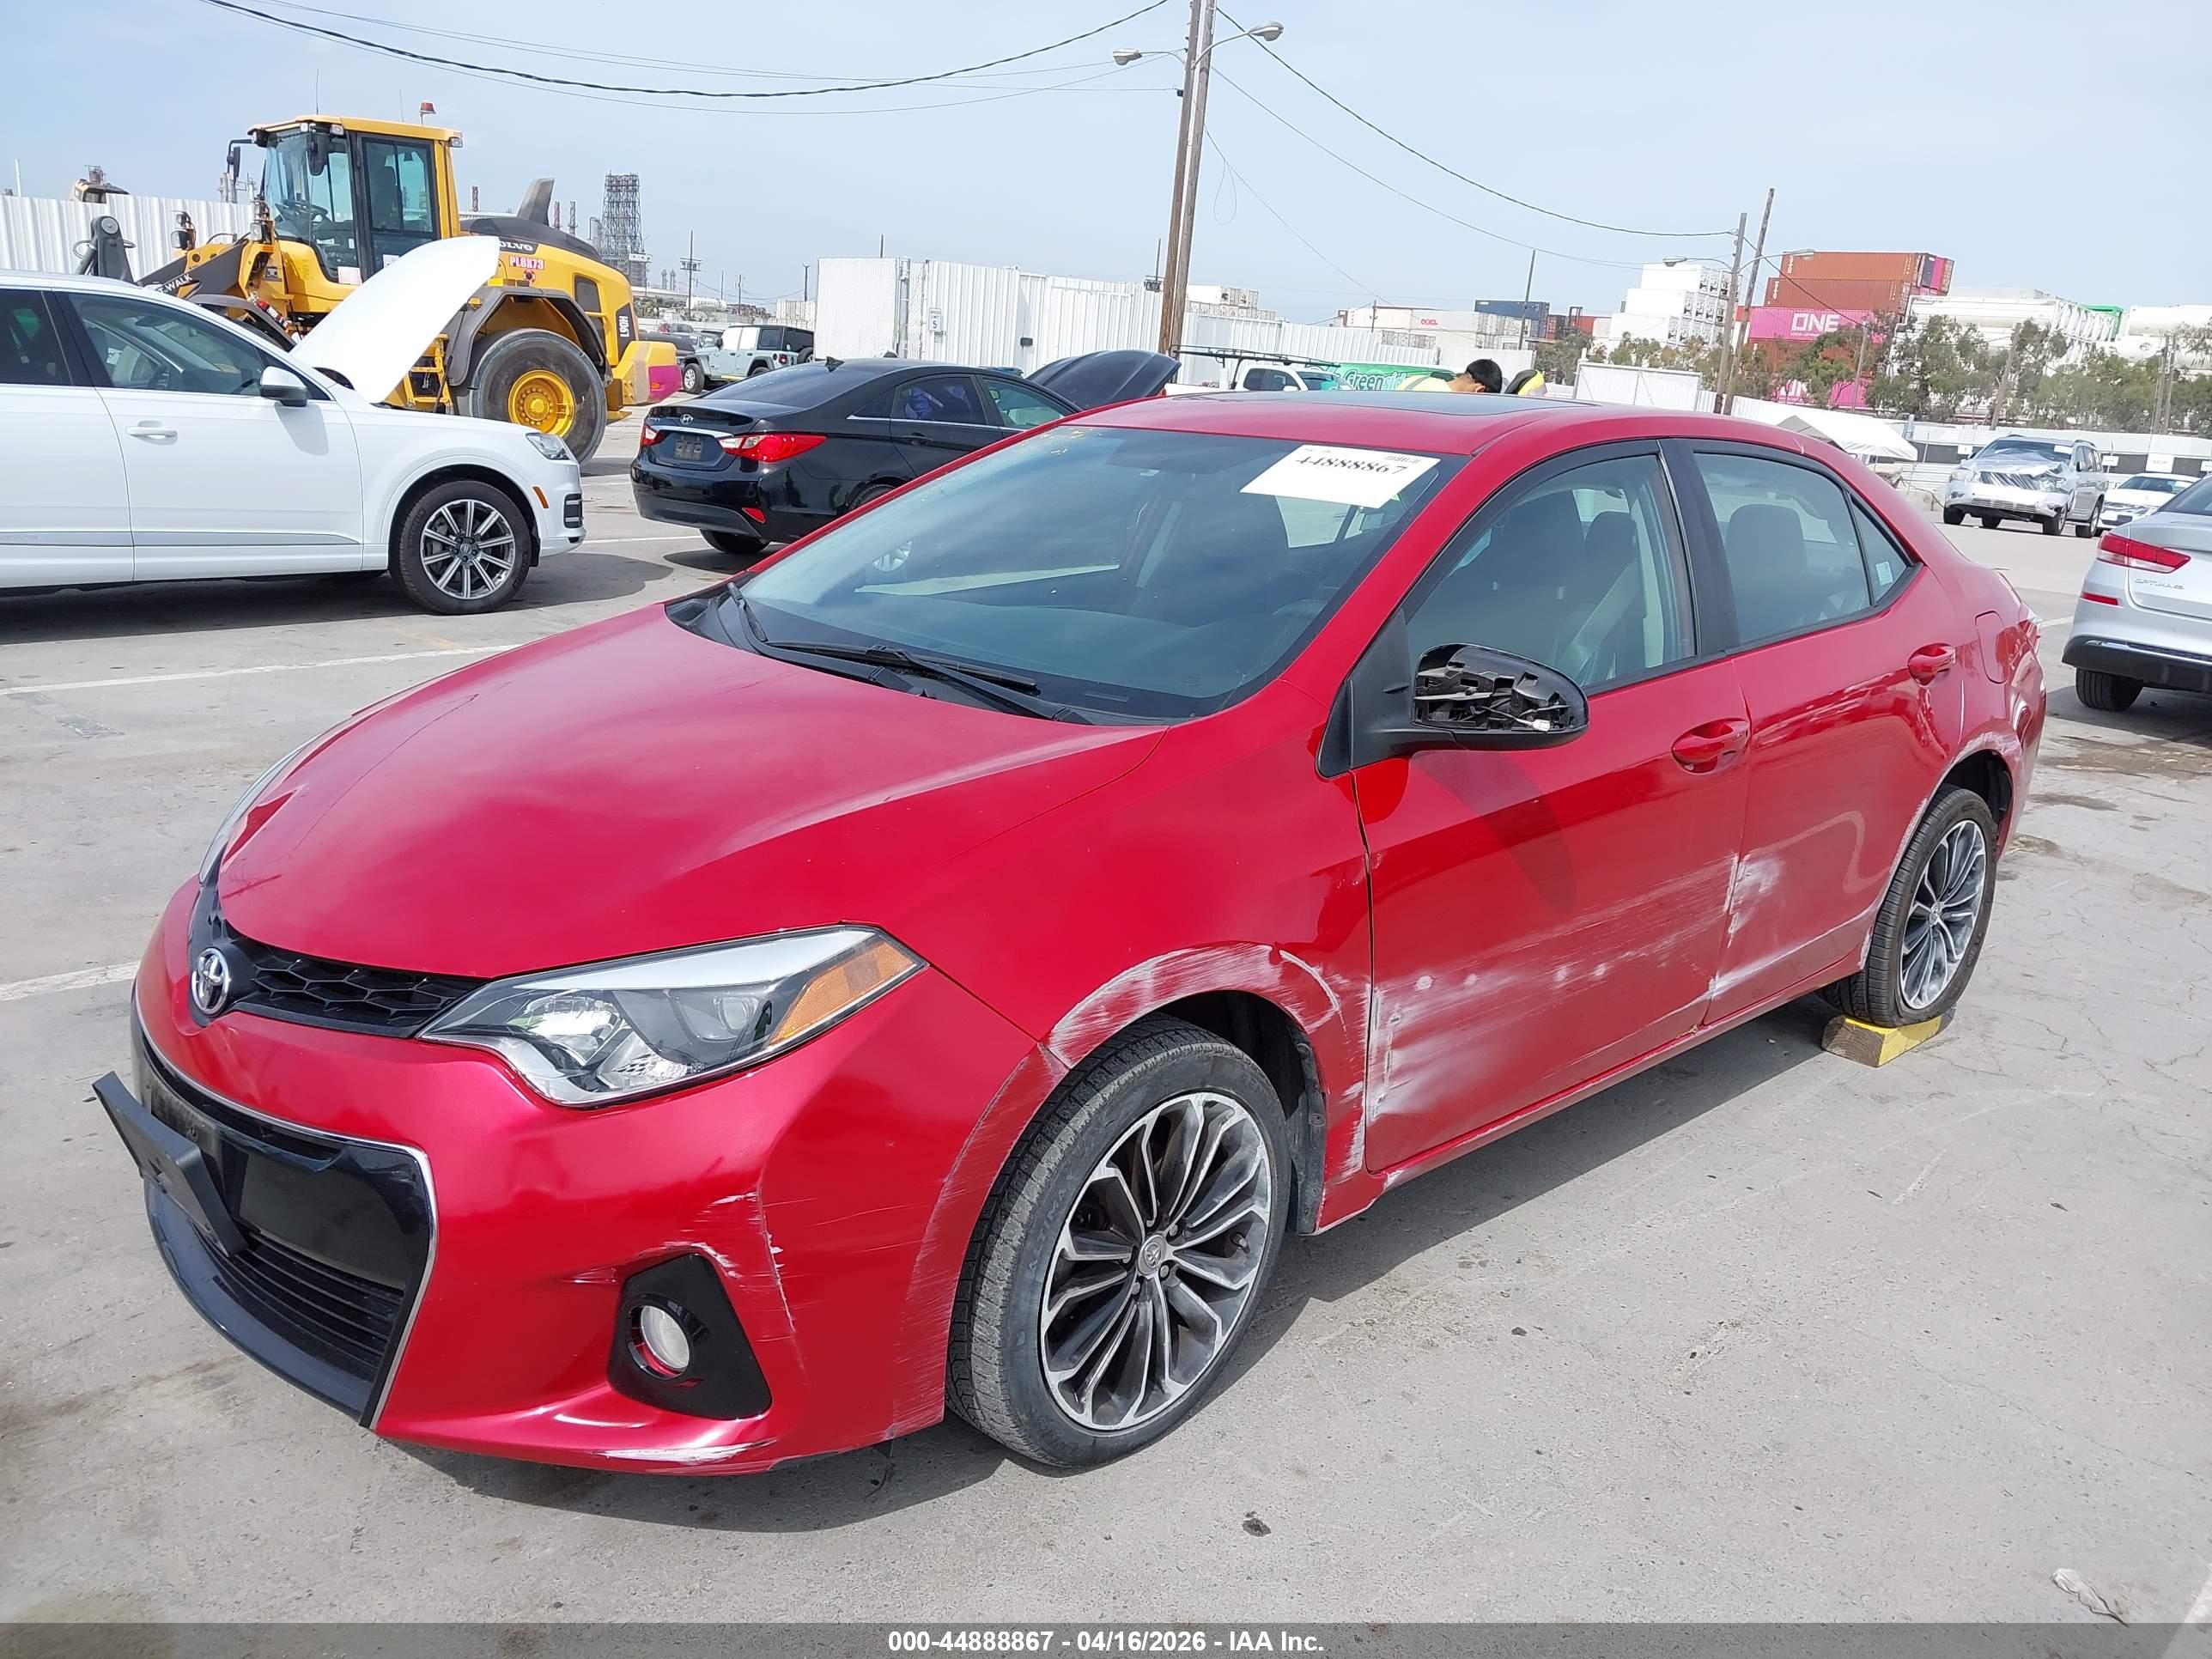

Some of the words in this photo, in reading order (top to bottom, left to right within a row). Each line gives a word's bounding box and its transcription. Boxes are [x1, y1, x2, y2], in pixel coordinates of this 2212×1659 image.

[499, 241, 533, 252] OLVO
[165, 273, 192, 291] WALK
[618, 315, 630, 337] L90H
[932, 320, 938, 329] 5
[1790, 313, 1840, 332] ONE
[1344, 368, 1408, 391] Greensid
[1294, 455, 1409, 475] 44888867
